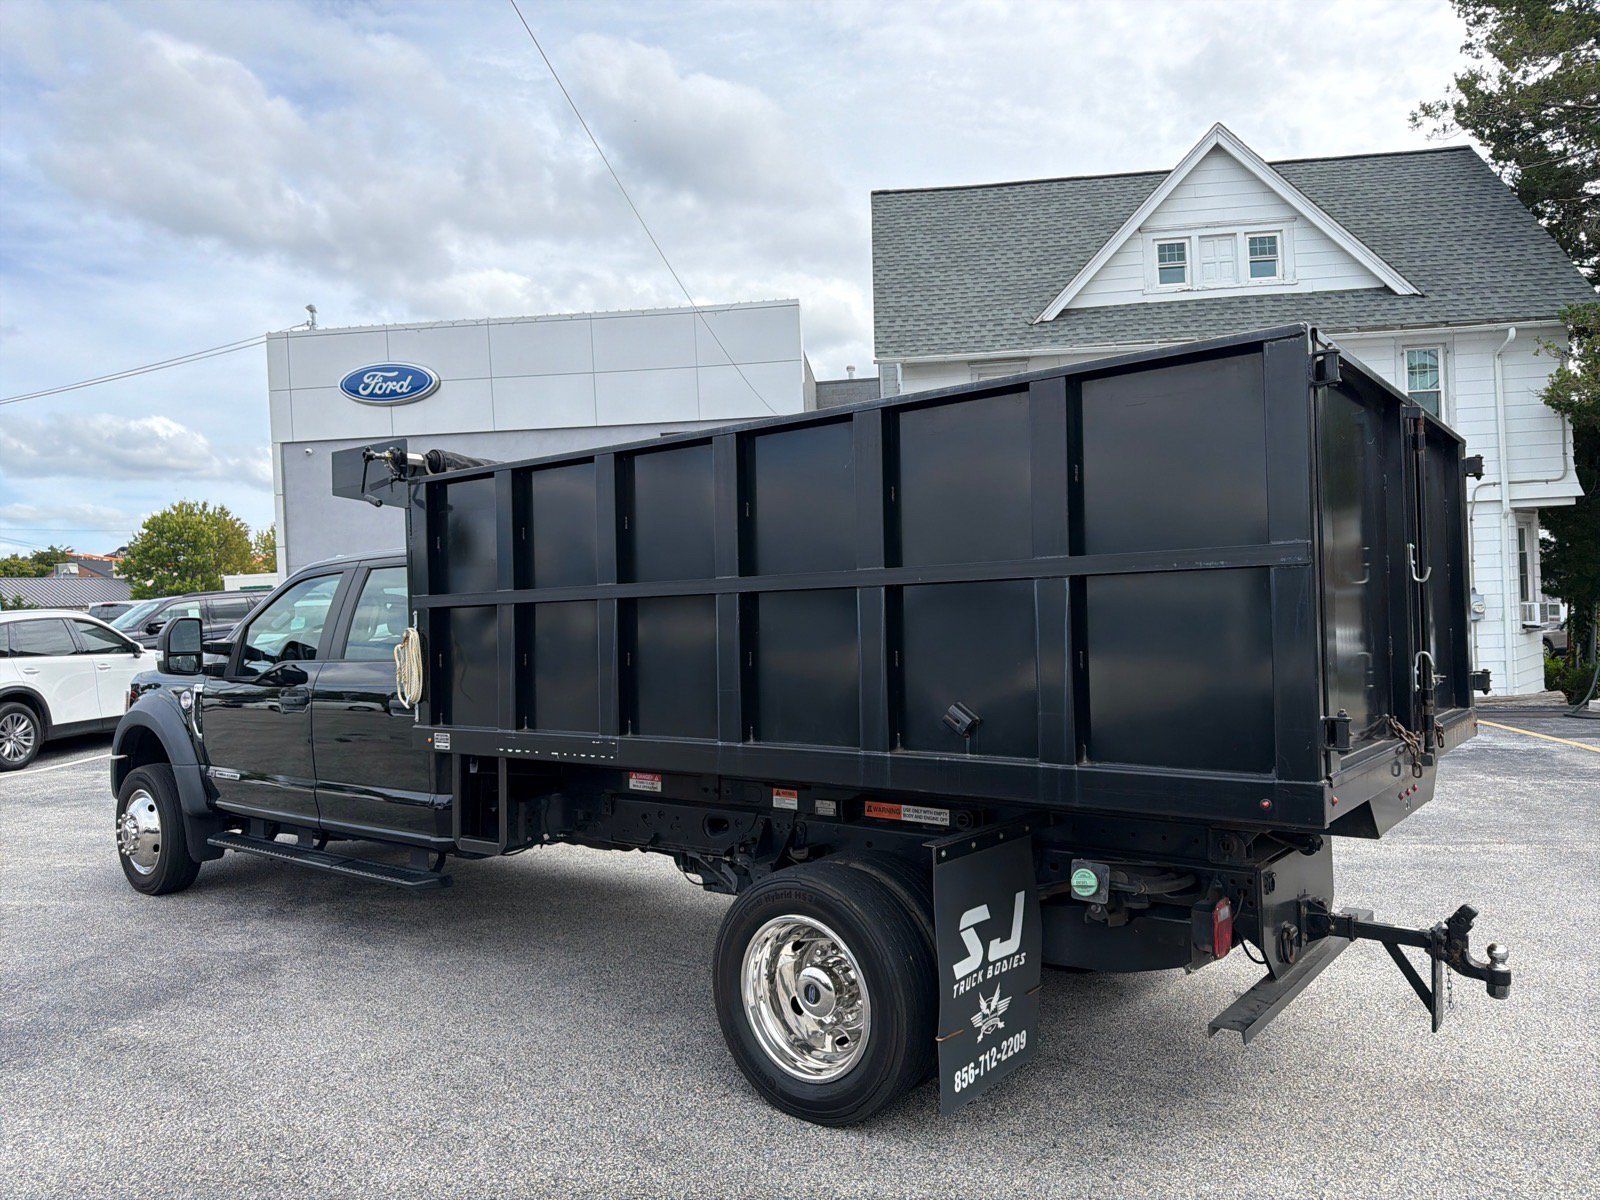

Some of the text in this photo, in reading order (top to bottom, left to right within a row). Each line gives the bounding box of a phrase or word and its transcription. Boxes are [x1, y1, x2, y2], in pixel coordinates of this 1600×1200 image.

[359, 371, 413, 395] Ford
[873, 805, 901, 815] WARNING
[765, 890, 792, 903] Hybrid
[953, 890, 1025, 980] SJ
[953, 952, 1026, 999] TRUCK BODIES
[954, 1030, 1026, 1093] 856-712-2209
